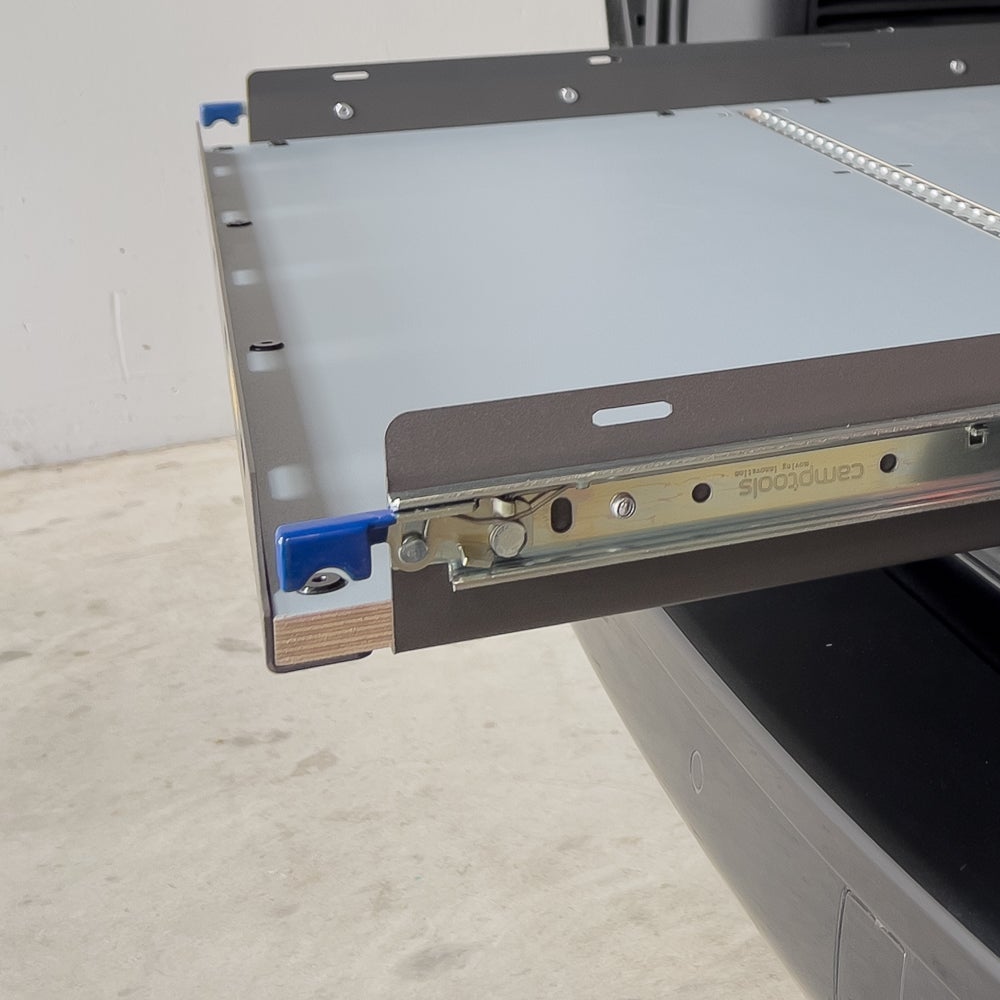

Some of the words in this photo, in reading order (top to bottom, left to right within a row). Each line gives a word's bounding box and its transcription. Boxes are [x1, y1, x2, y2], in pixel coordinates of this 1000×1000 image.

[734, 465, 777, 478] innovation
[782, 461, 810, 471] moving
[739, 463, 864, 499] camptools
